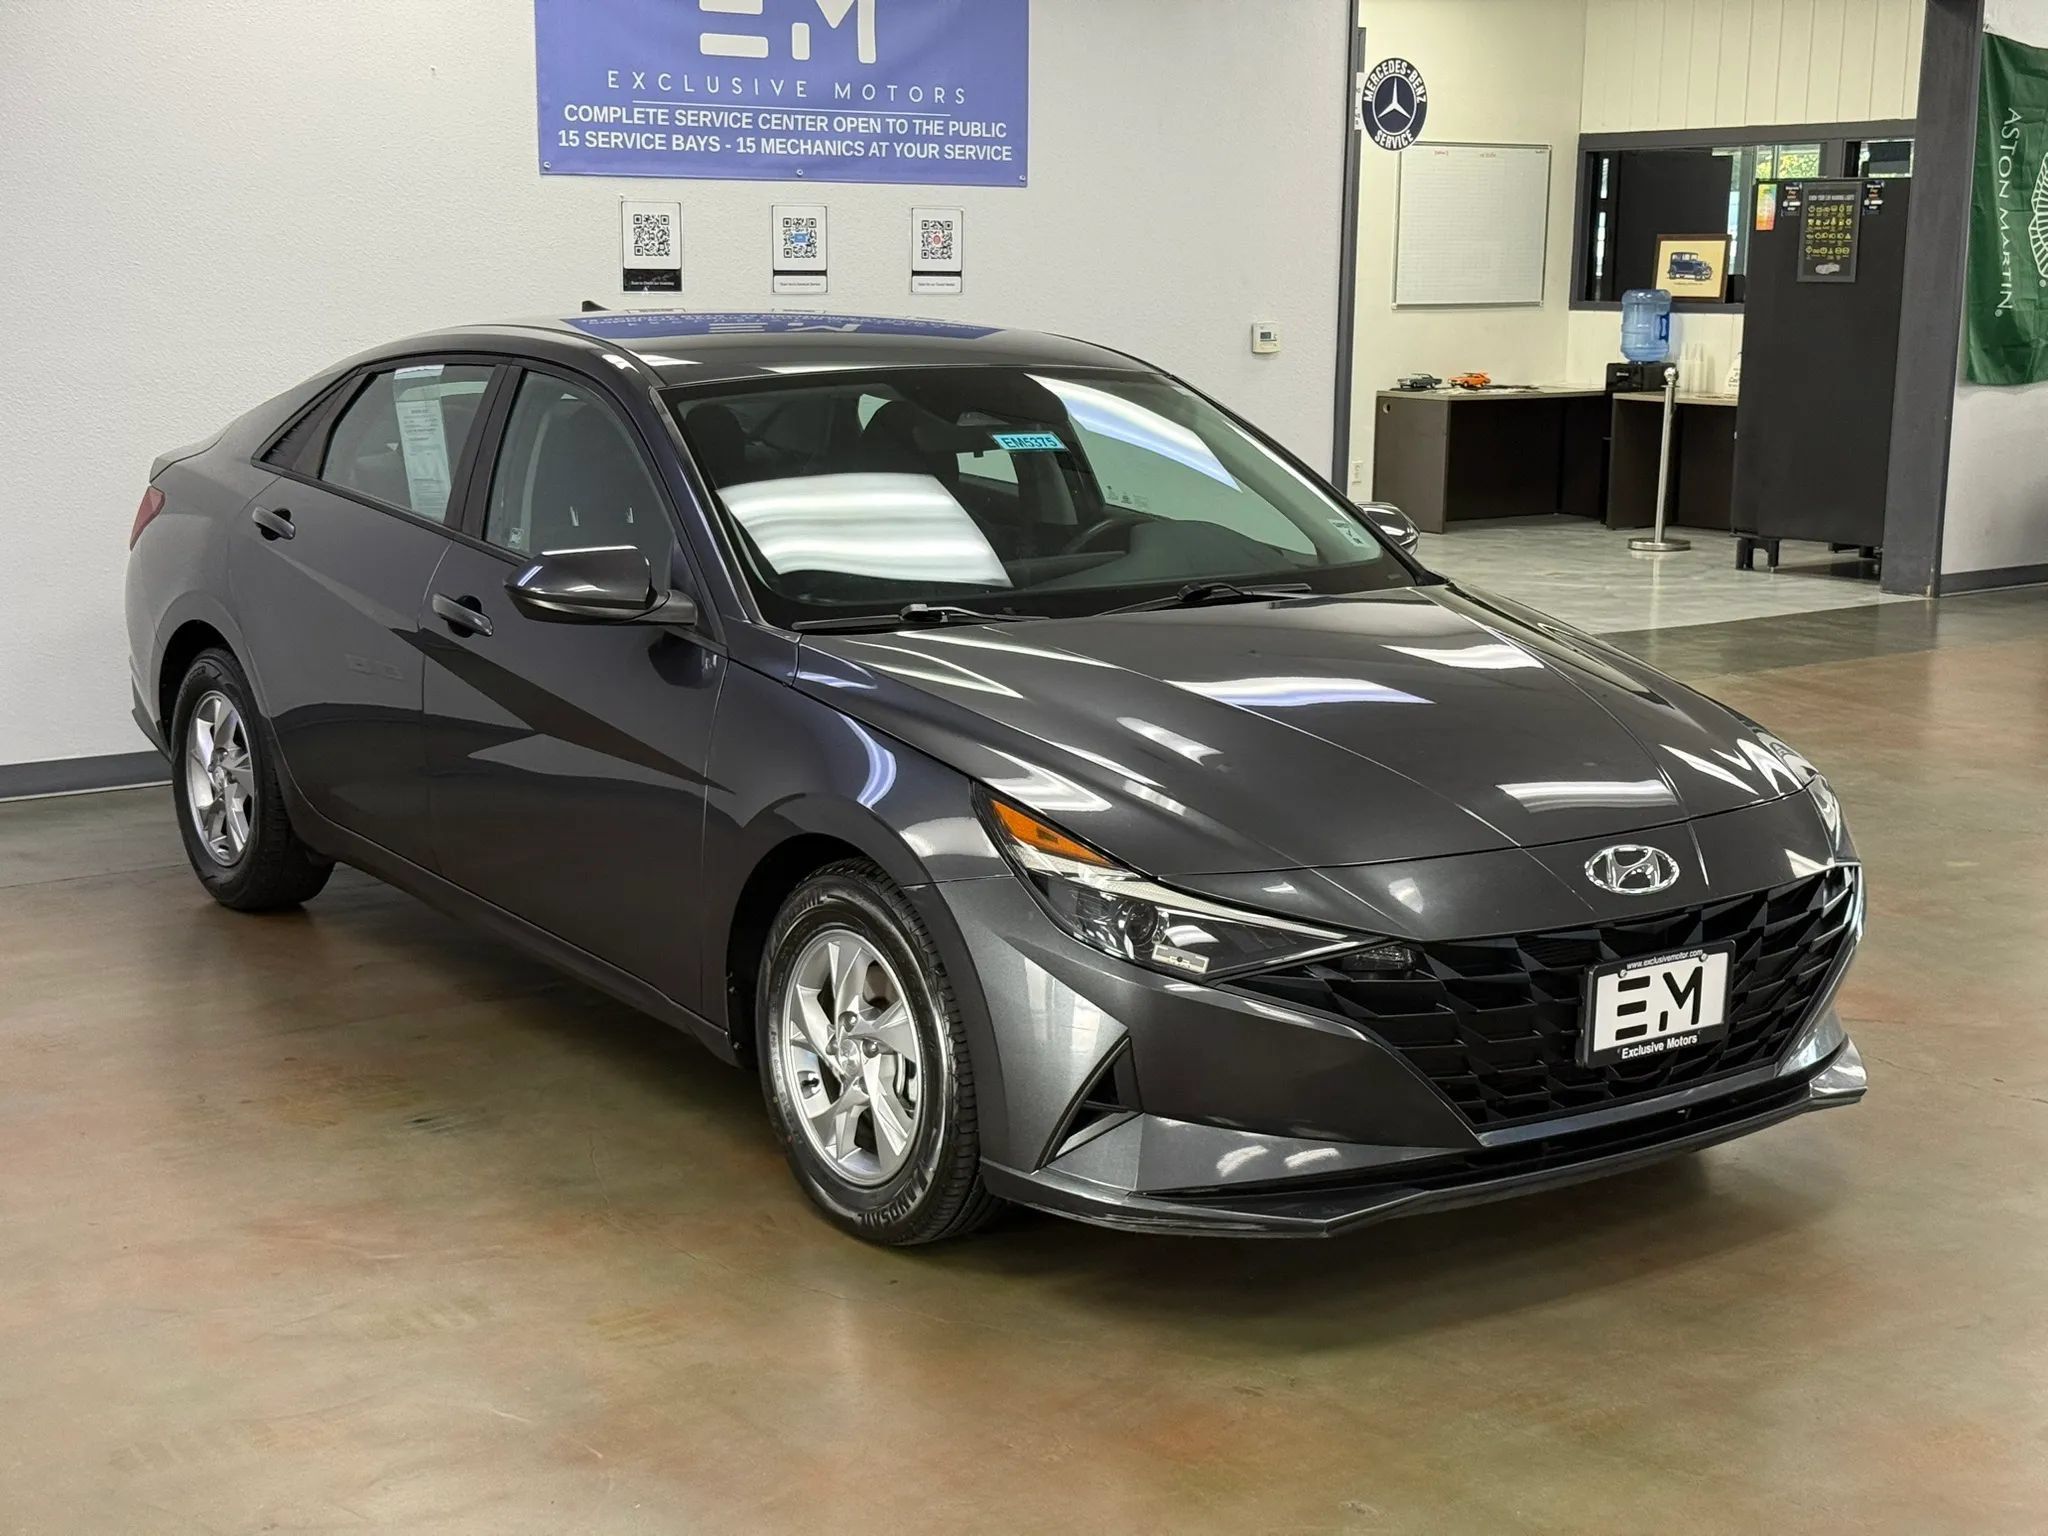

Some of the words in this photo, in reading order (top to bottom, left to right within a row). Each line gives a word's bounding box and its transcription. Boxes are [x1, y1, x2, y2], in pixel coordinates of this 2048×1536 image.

[607, 70, 807, 98] EXCLUSIVE
[834, 82, 966, 105] MOTORS
[1363, 60, 1427, 104] MERCEDES-BENZ
[564, 104, 669, 126] COMPLETE
[674, 109, 753, 129] SERVICE
[757, 112, 829, 132] CENTER
[833, 116, 881, 134] OPEN
[885, 118, 909, 135] TO
[912, 119, 944, 136] THE
[948, 121, 1007, 138] PUBLIC
[558, 130, 580, 147] 15
[584, 131, 667, 151] SERVICE
[671, 135, 721, 152] BAYS
[736, 137, 756, 154] 15
[760, 138, 865, 157] MECHANICS
[868, 141, 890, 157] AT
[893, 142, 940, 159] YOUR
[943, 144, 1013, 161] SERVICE
[1374, 129, 1414, 149] SERVICE
[1998, 107, 2022, 198] ASTON
[1997, 207, 2013, 309] MARTIN
[1000, 437, 1058, 449] EM5375
[1626, 949, 1704, 970] www.exclusivemotor.com
[1615, 966, 1704, 1041] EM
[1621, 1042, 1664, 1059] Exclusive
[1667, 1034, 1698, 1050] Motors
